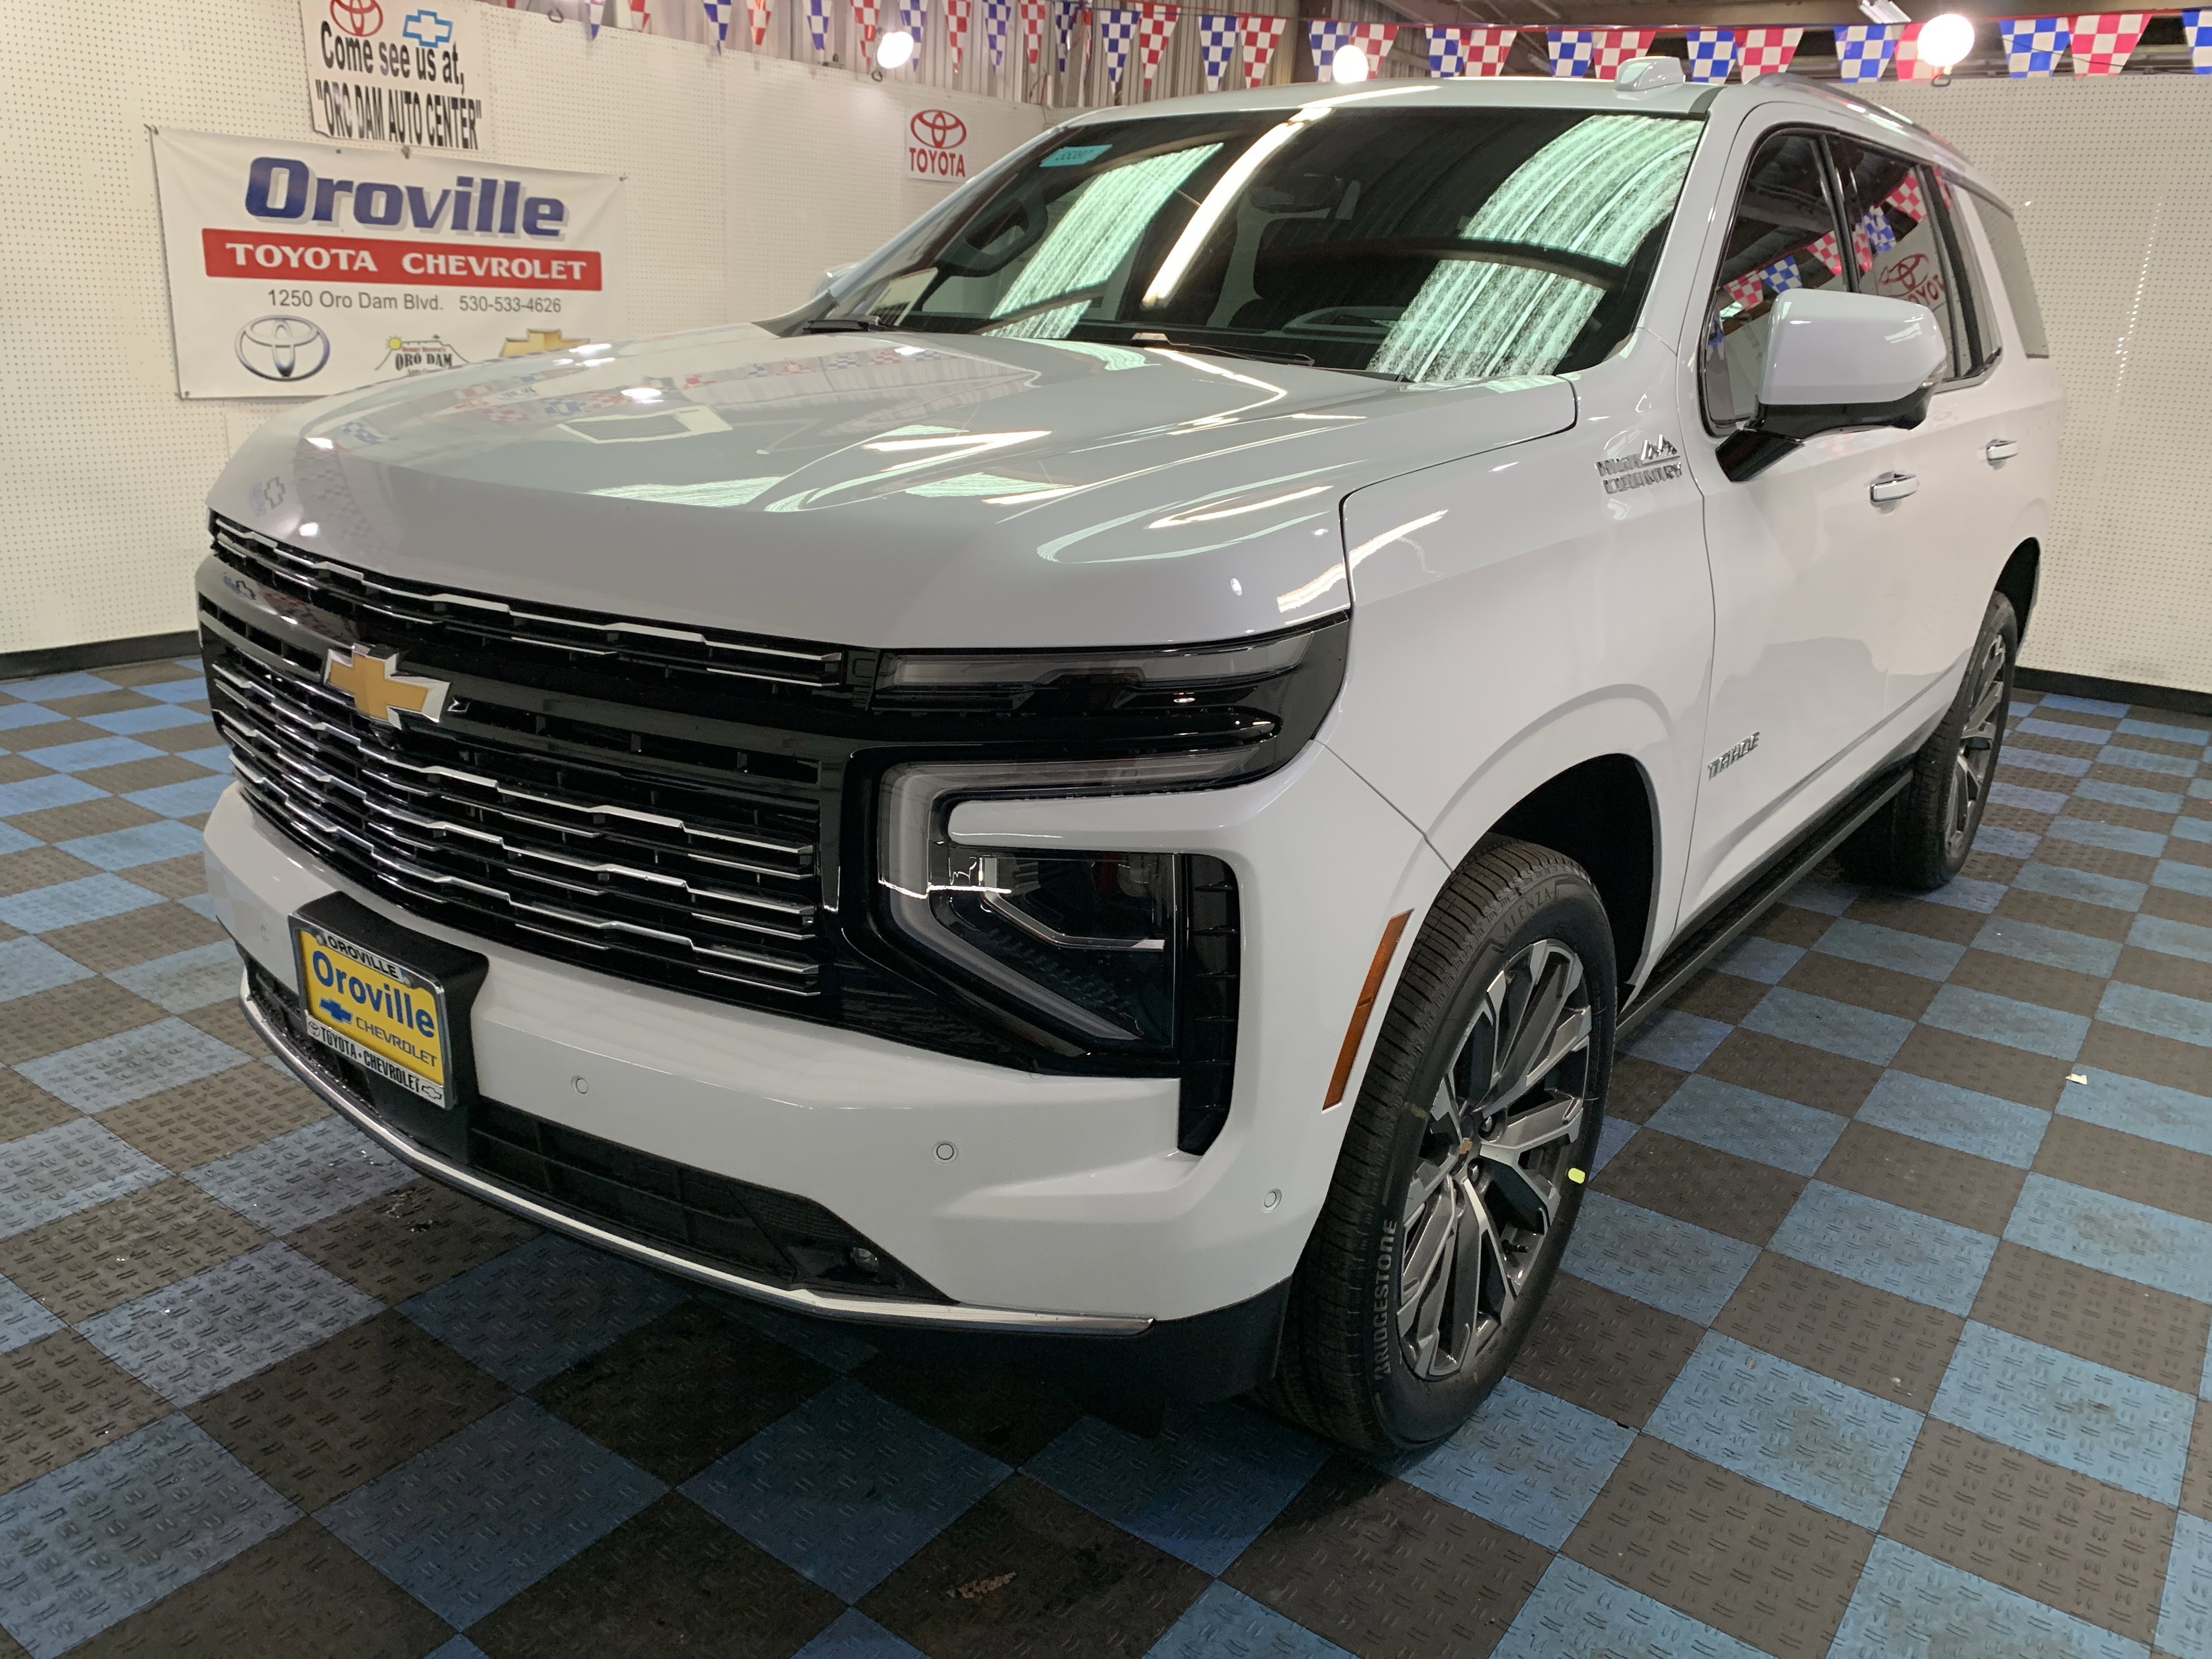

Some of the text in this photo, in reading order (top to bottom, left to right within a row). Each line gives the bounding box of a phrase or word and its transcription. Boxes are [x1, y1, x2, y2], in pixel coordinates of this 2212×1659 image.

[320, 20, 465, 94] Come see us at,
[354, 84, 384, 141] DAM
[388, 88, 422, 145] AUTO
[909, 146, 966, 178] TOYOTA
[245, 156, 567, 238] Oroville
[225, 242, 587, 280] TOYOTA CHEVROLET
[268, 290, 561, 313] 1250 Oro Dam Blvd. 530-533-4626
[395, 353, 452, 371] ORO DAM
[327, 935, 399, 979] OROVILLE
[312, 950, 435, 1038] Oroville
[320, 1026, 420, 1093] TOYOTA CHEVROLET
[355, 1017, 437, 1067] CHEVROLET
